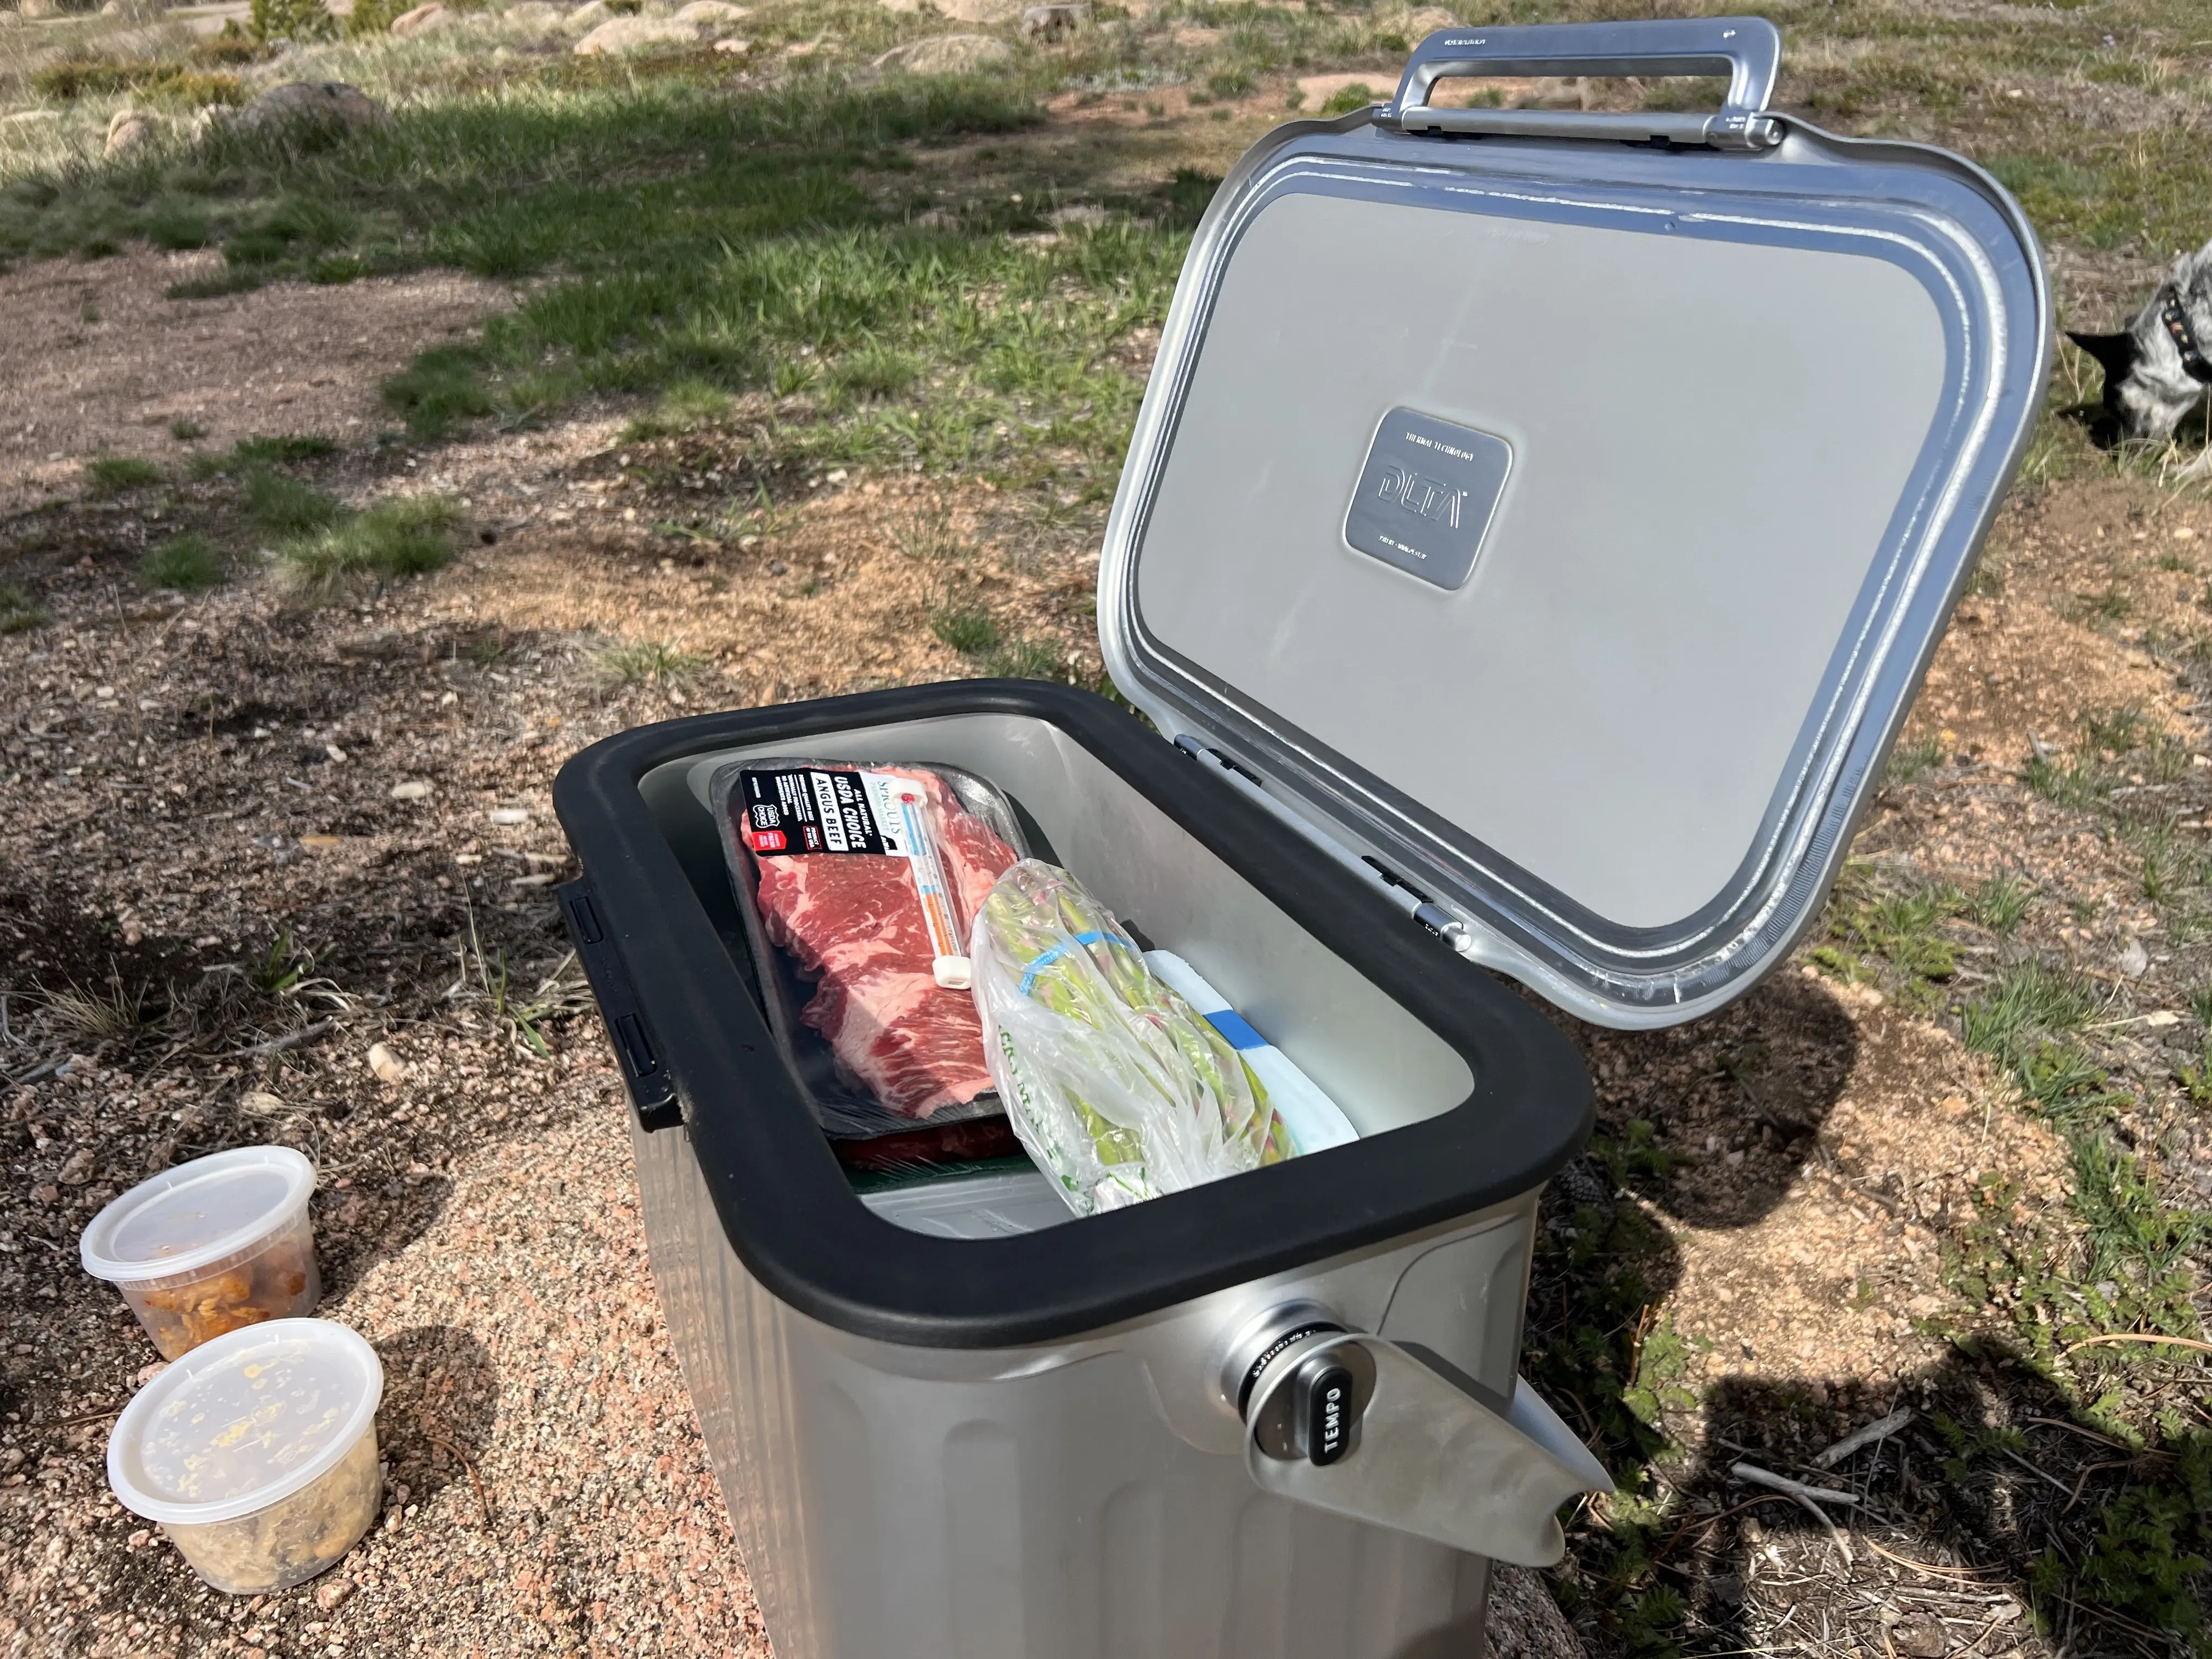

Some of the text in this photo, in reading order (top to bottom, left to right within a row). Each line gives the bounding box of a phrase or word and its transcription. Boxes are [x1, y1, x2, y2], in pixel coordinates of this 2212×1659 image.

[802, 792, 811, 811] QUALITY
[854, 788, 863, 802] ALL
[757, 806, 768, 826] CHOICE
[768, 807, 776, 824] USDA
[816, 778, 842, 844] ANGUS BEEF
[834, 776, 867, 848] USDA CHOICE
[1324, 1387, 1341, 1454] TEMPO
